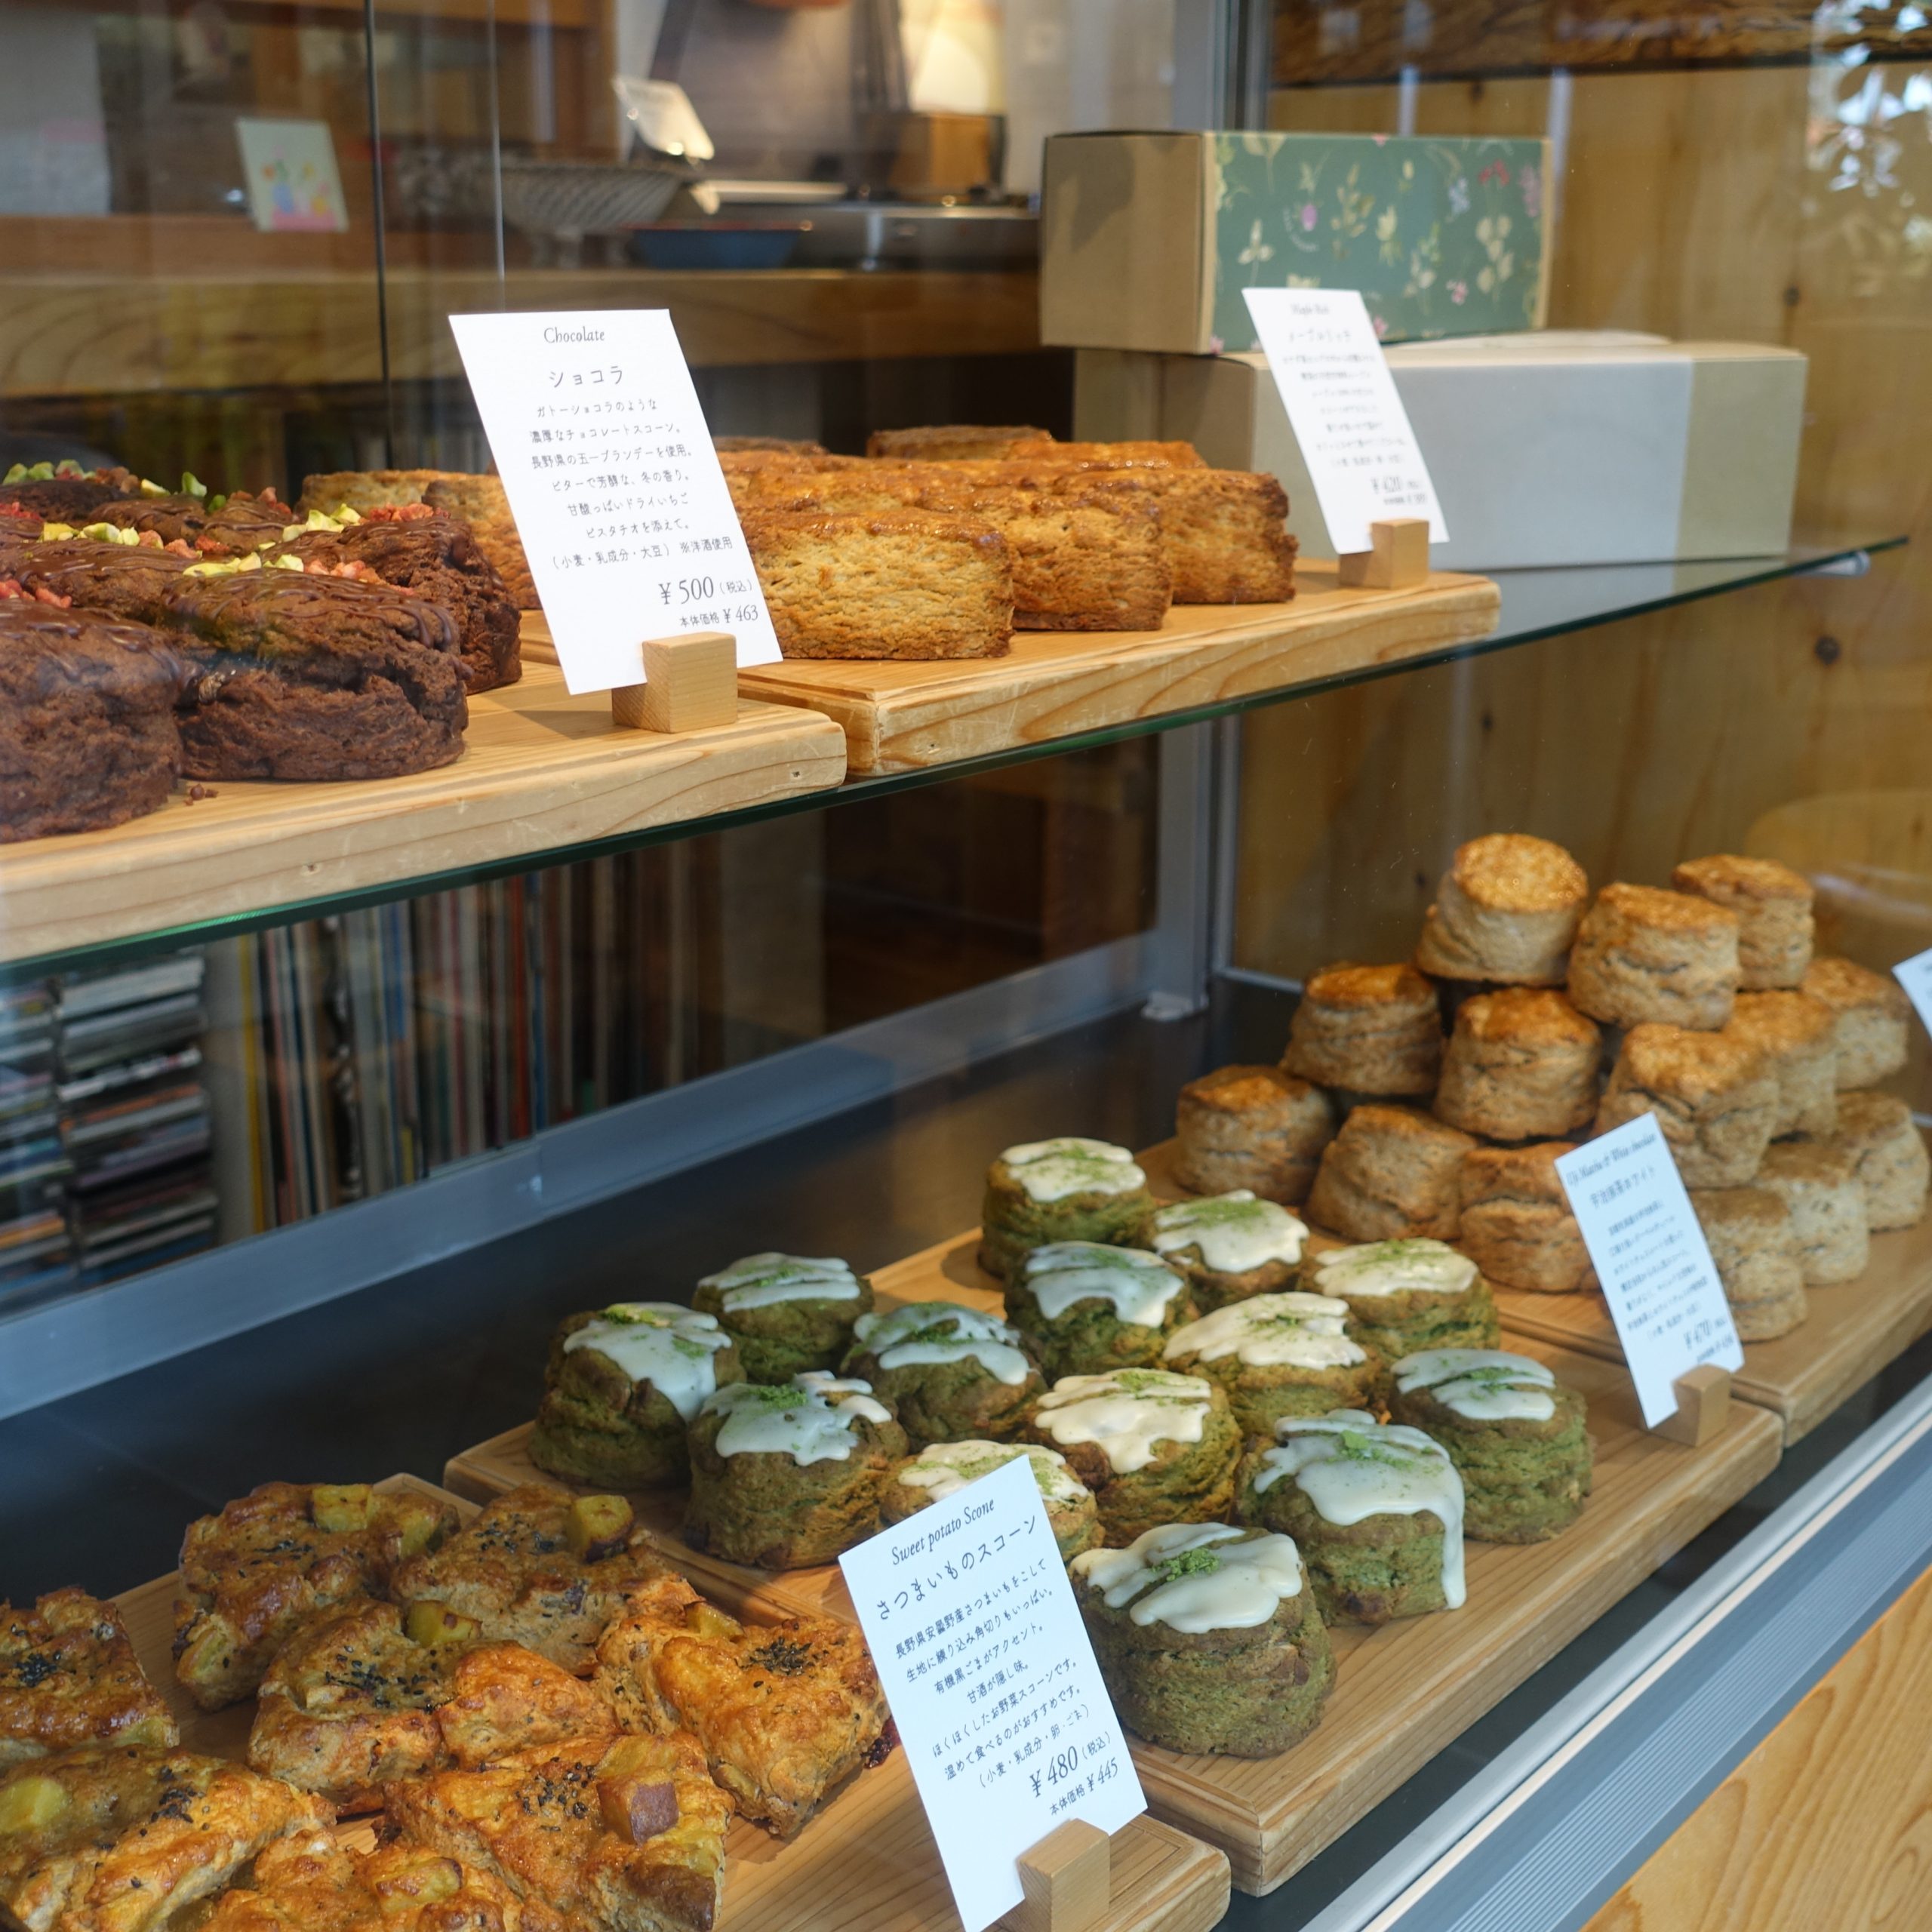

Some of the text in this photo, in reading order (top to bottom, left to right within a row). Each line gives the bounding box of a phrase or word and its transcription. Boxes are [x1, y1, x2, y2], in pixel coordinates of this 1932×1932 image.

[543, 325, 605, 344] Chocolate
[549, 365, 623, 389] ショコラ
[537, 398, 657, 418] ガトーショコラのような
[678, 611, 720, 628] 本体価格
[891, 1499, 995, 1566] Sweet potato Scone
[876, 1515, 1035, 1621] さつまいものスコーン
[934, 1622, 1043, 1695] 有機黒ごまがアクセント。
[966, 1660, 1029, 1704] 甘酒が隠し味。
[932, 1657, 1077, 1758] ほくほくしたお野菜スコーンです。
[944, 1684, 1080, 1781] 温めて食べるのがおすすめです。
[1049, 1783, 1086, 1816] 本体価格
